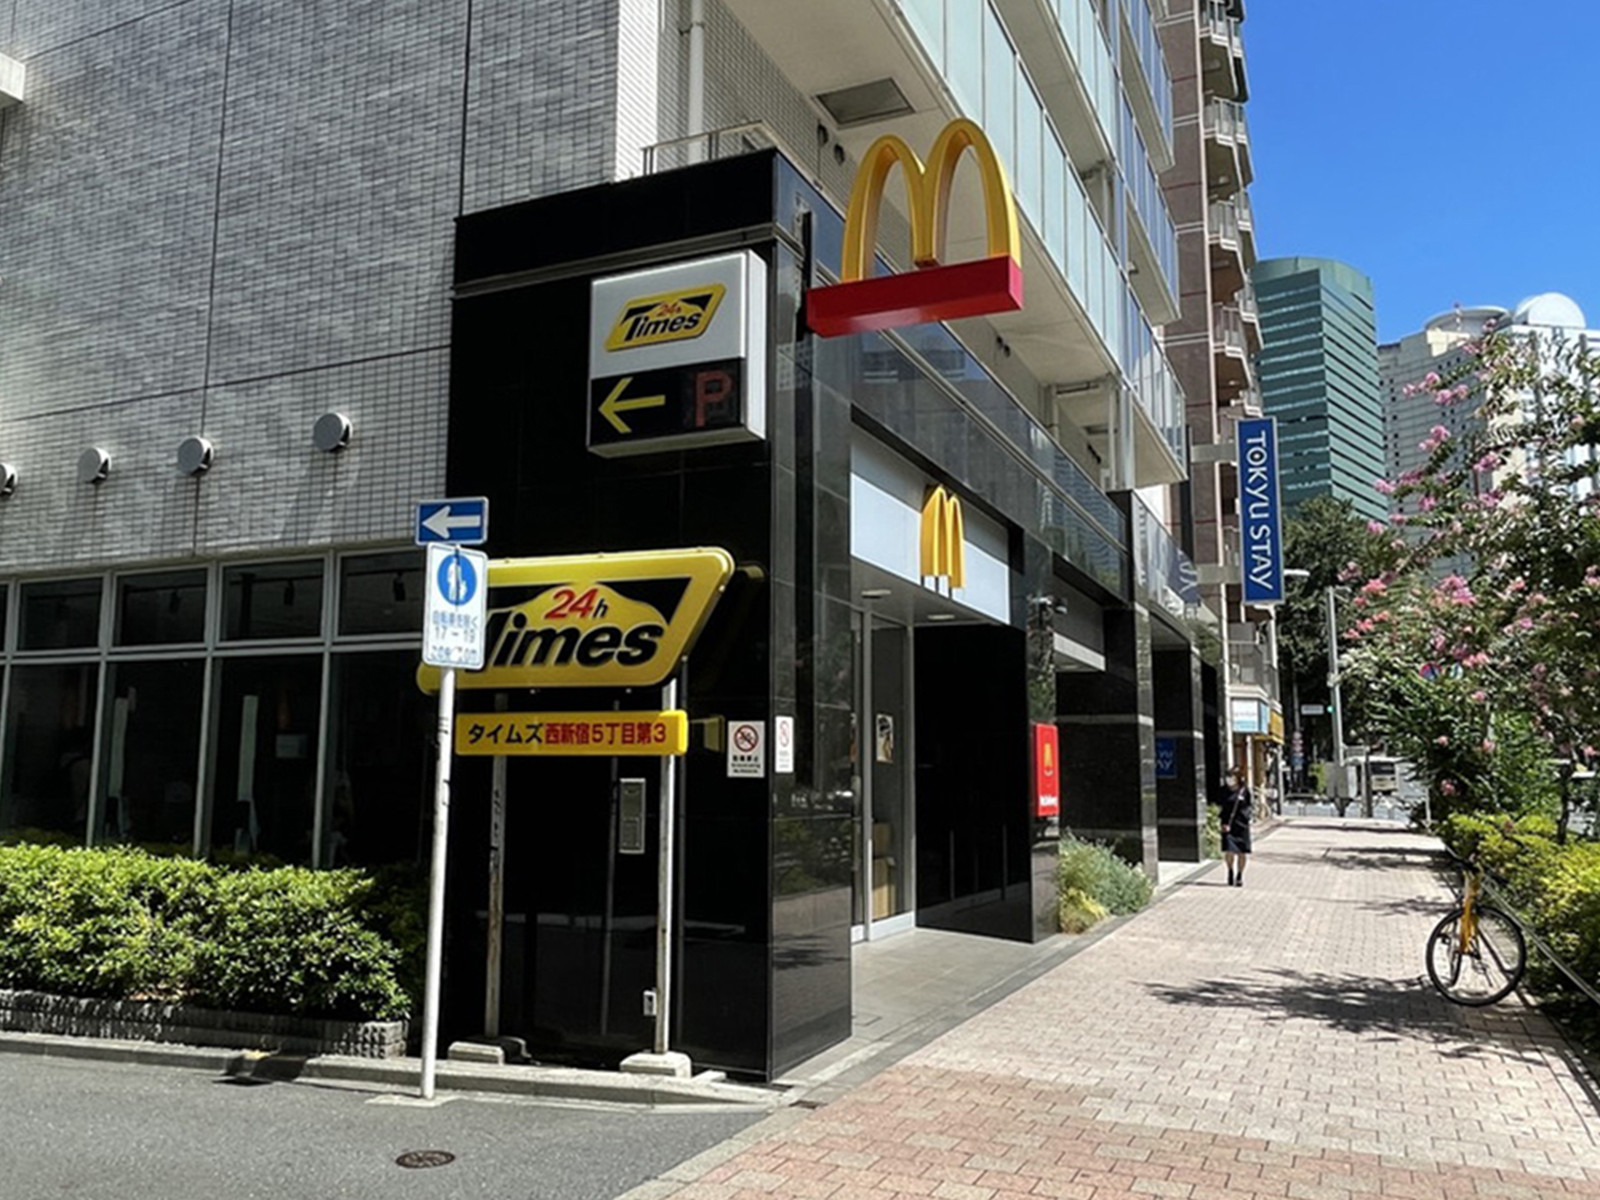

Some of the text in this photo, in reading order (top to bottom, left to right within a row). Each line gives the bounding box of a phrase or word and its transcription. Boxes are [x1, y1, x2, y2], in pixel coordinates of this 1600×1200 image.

[624, 312, 702, 342] Times
[695, 370, 732, 427] P
[1245, 430, 1274, 591] TOKYU STAY
[544, 587, 609, 620] 24h
